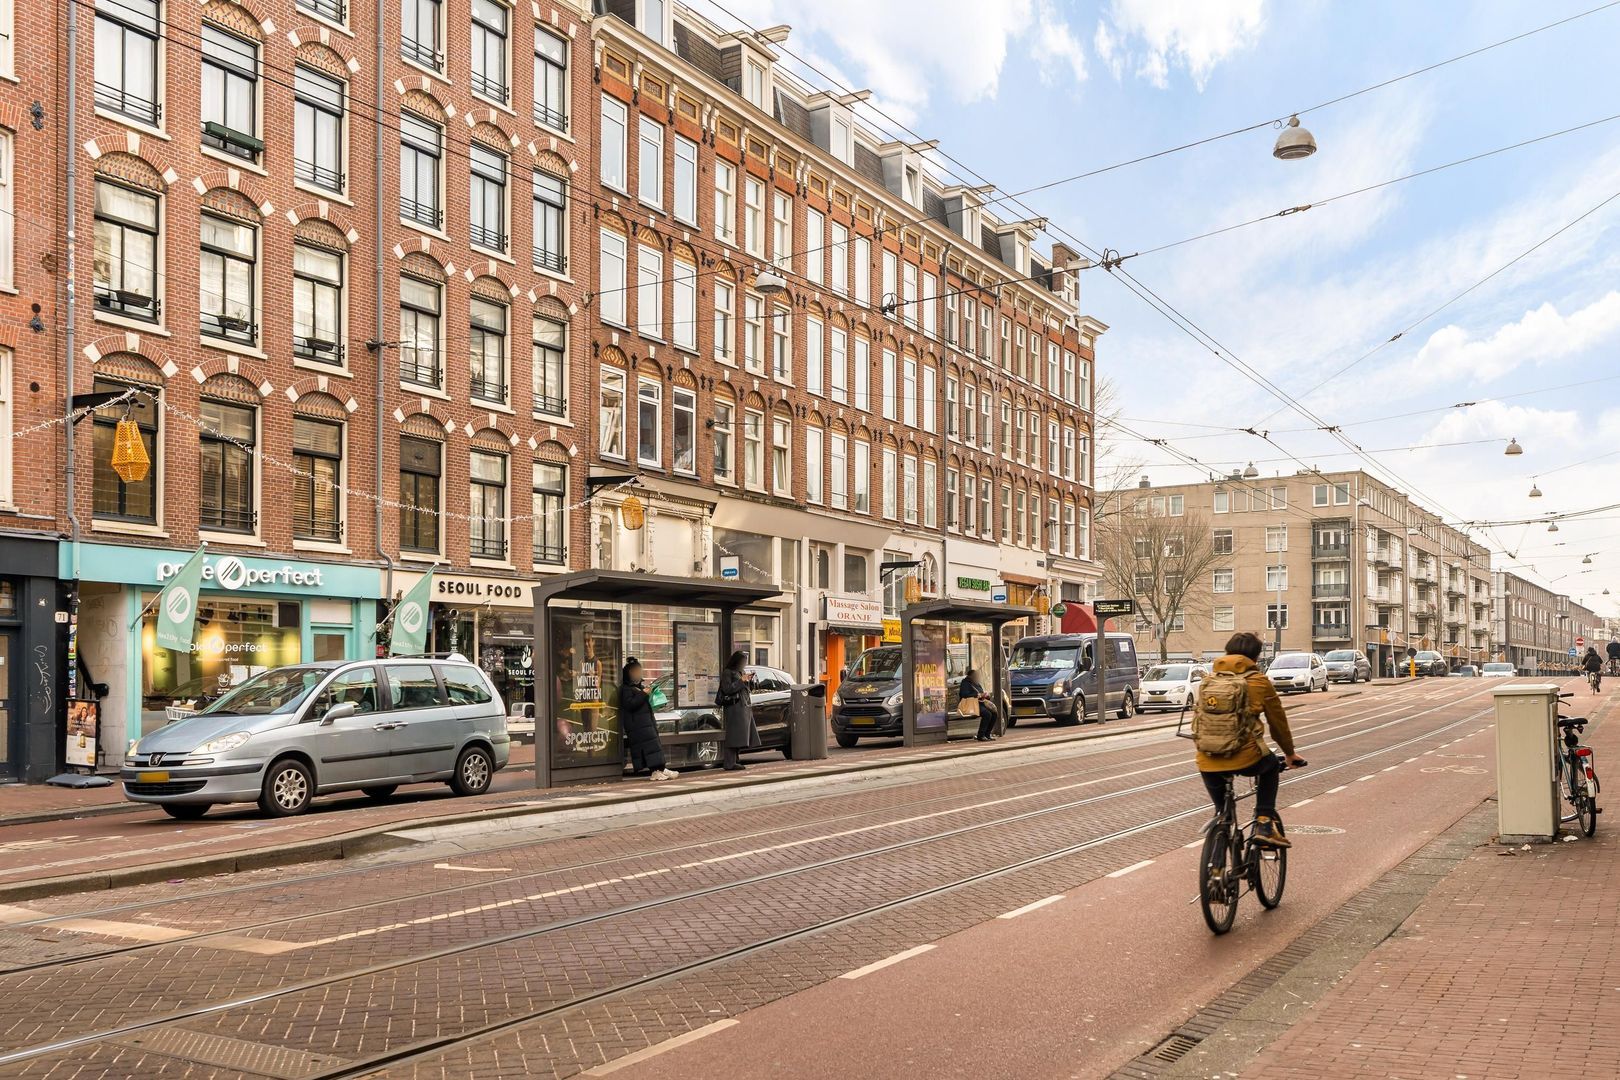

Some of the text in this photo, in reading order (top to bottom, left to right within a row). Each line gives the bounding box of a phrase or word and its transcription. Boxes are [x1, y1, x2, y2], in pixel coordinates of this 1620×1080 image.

[247, 565, 324, 586] perfect
[439, 580, 522, 598] SEOUL FOOD
[829, 599, 880, 611] Massage Salon
[837, 612, 872, 621] ORANJE
[225, 641, 268, 653] perfect
[581, 662, 595, 674] KOM
[921, 664, 937, 674] MND
[576, 675, 600, 687] WINTER
[574, 687, 602, 700] SPORTEN
